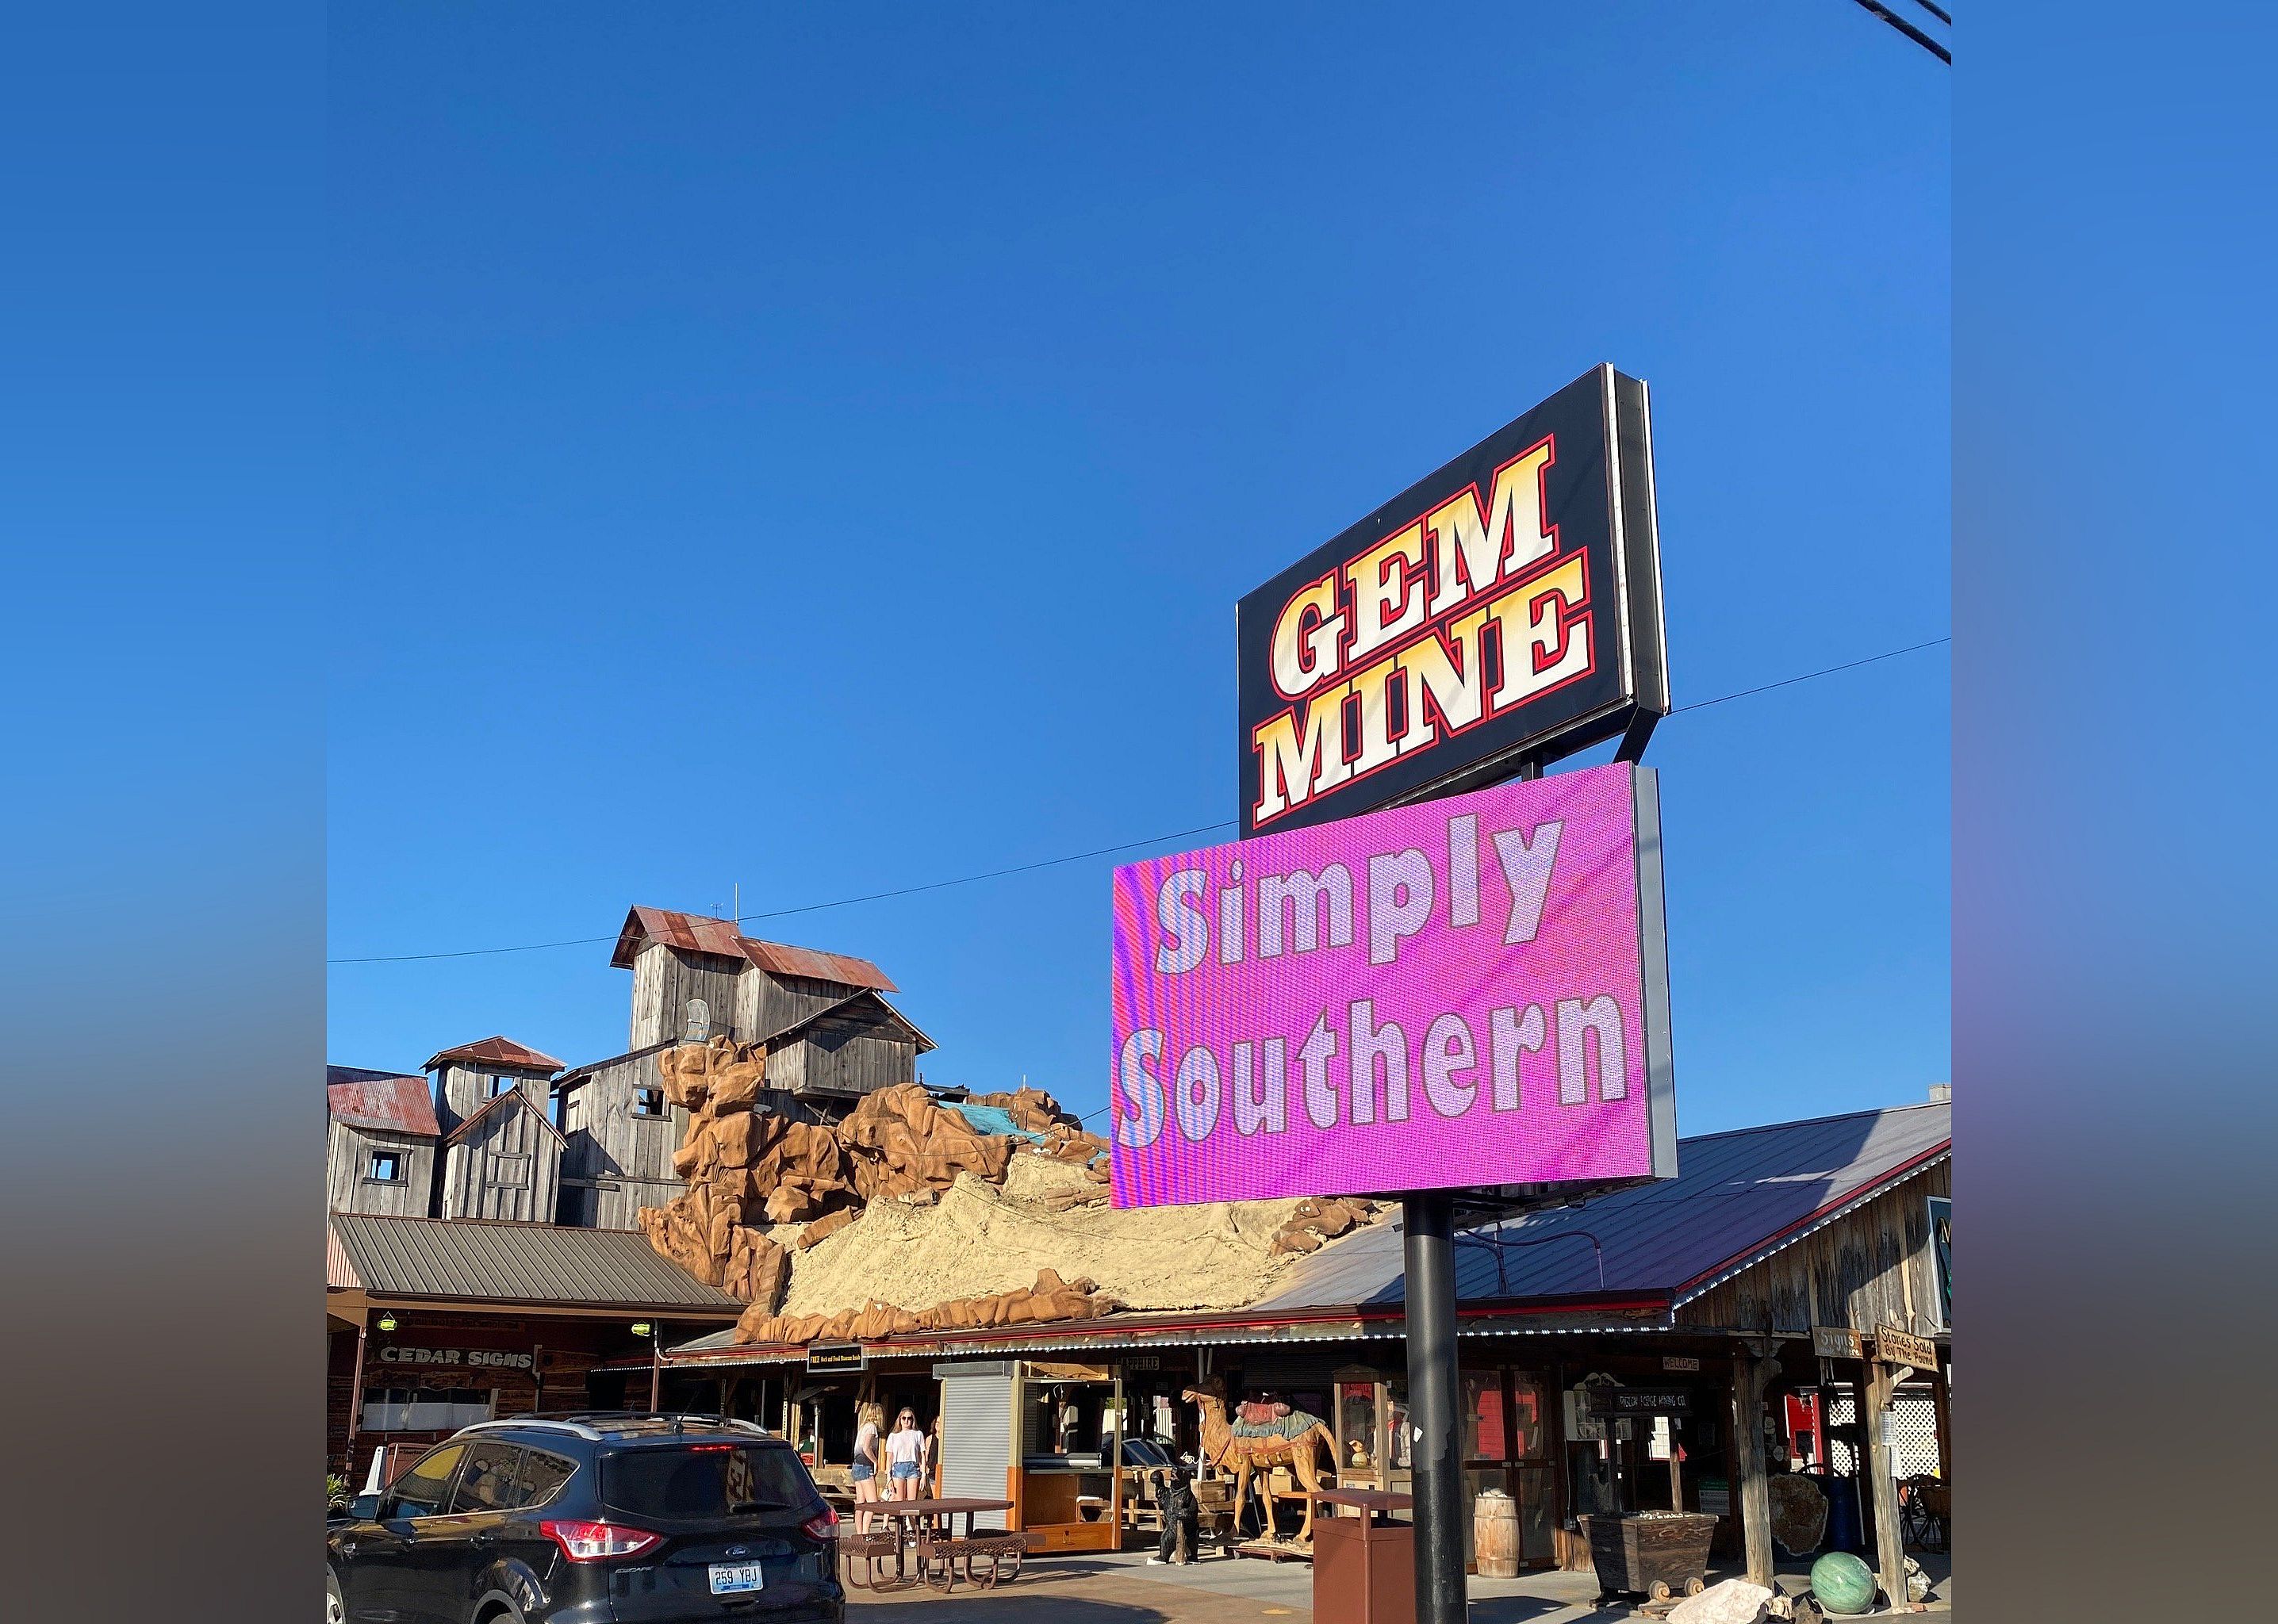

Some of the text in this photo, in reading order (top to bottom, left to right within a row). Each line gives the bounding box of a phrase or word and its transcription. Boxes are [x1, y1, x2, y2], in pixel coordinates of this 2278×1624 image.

[1269, 433, 1560, 701] GEM
[1252, 546, 1595, 829] MINE
[1155, 813, 1566, 975] Simply
[1116, 994, 1628, 1149] Southern
[1820, 1332, 1854, 1351] Signs
[1881, 1327, 1932, 1354] Stones Sold
[380, 1347, 531, 1368] CEDAR SIGNS
[810, 1355, 820, 1364] FREE
[1665, 1358, 1697, 1369] WELCOME
[1885, 1346, 1934, 1365] By The Pound
[715, 1568, 757, 1585] 259 YBJ
